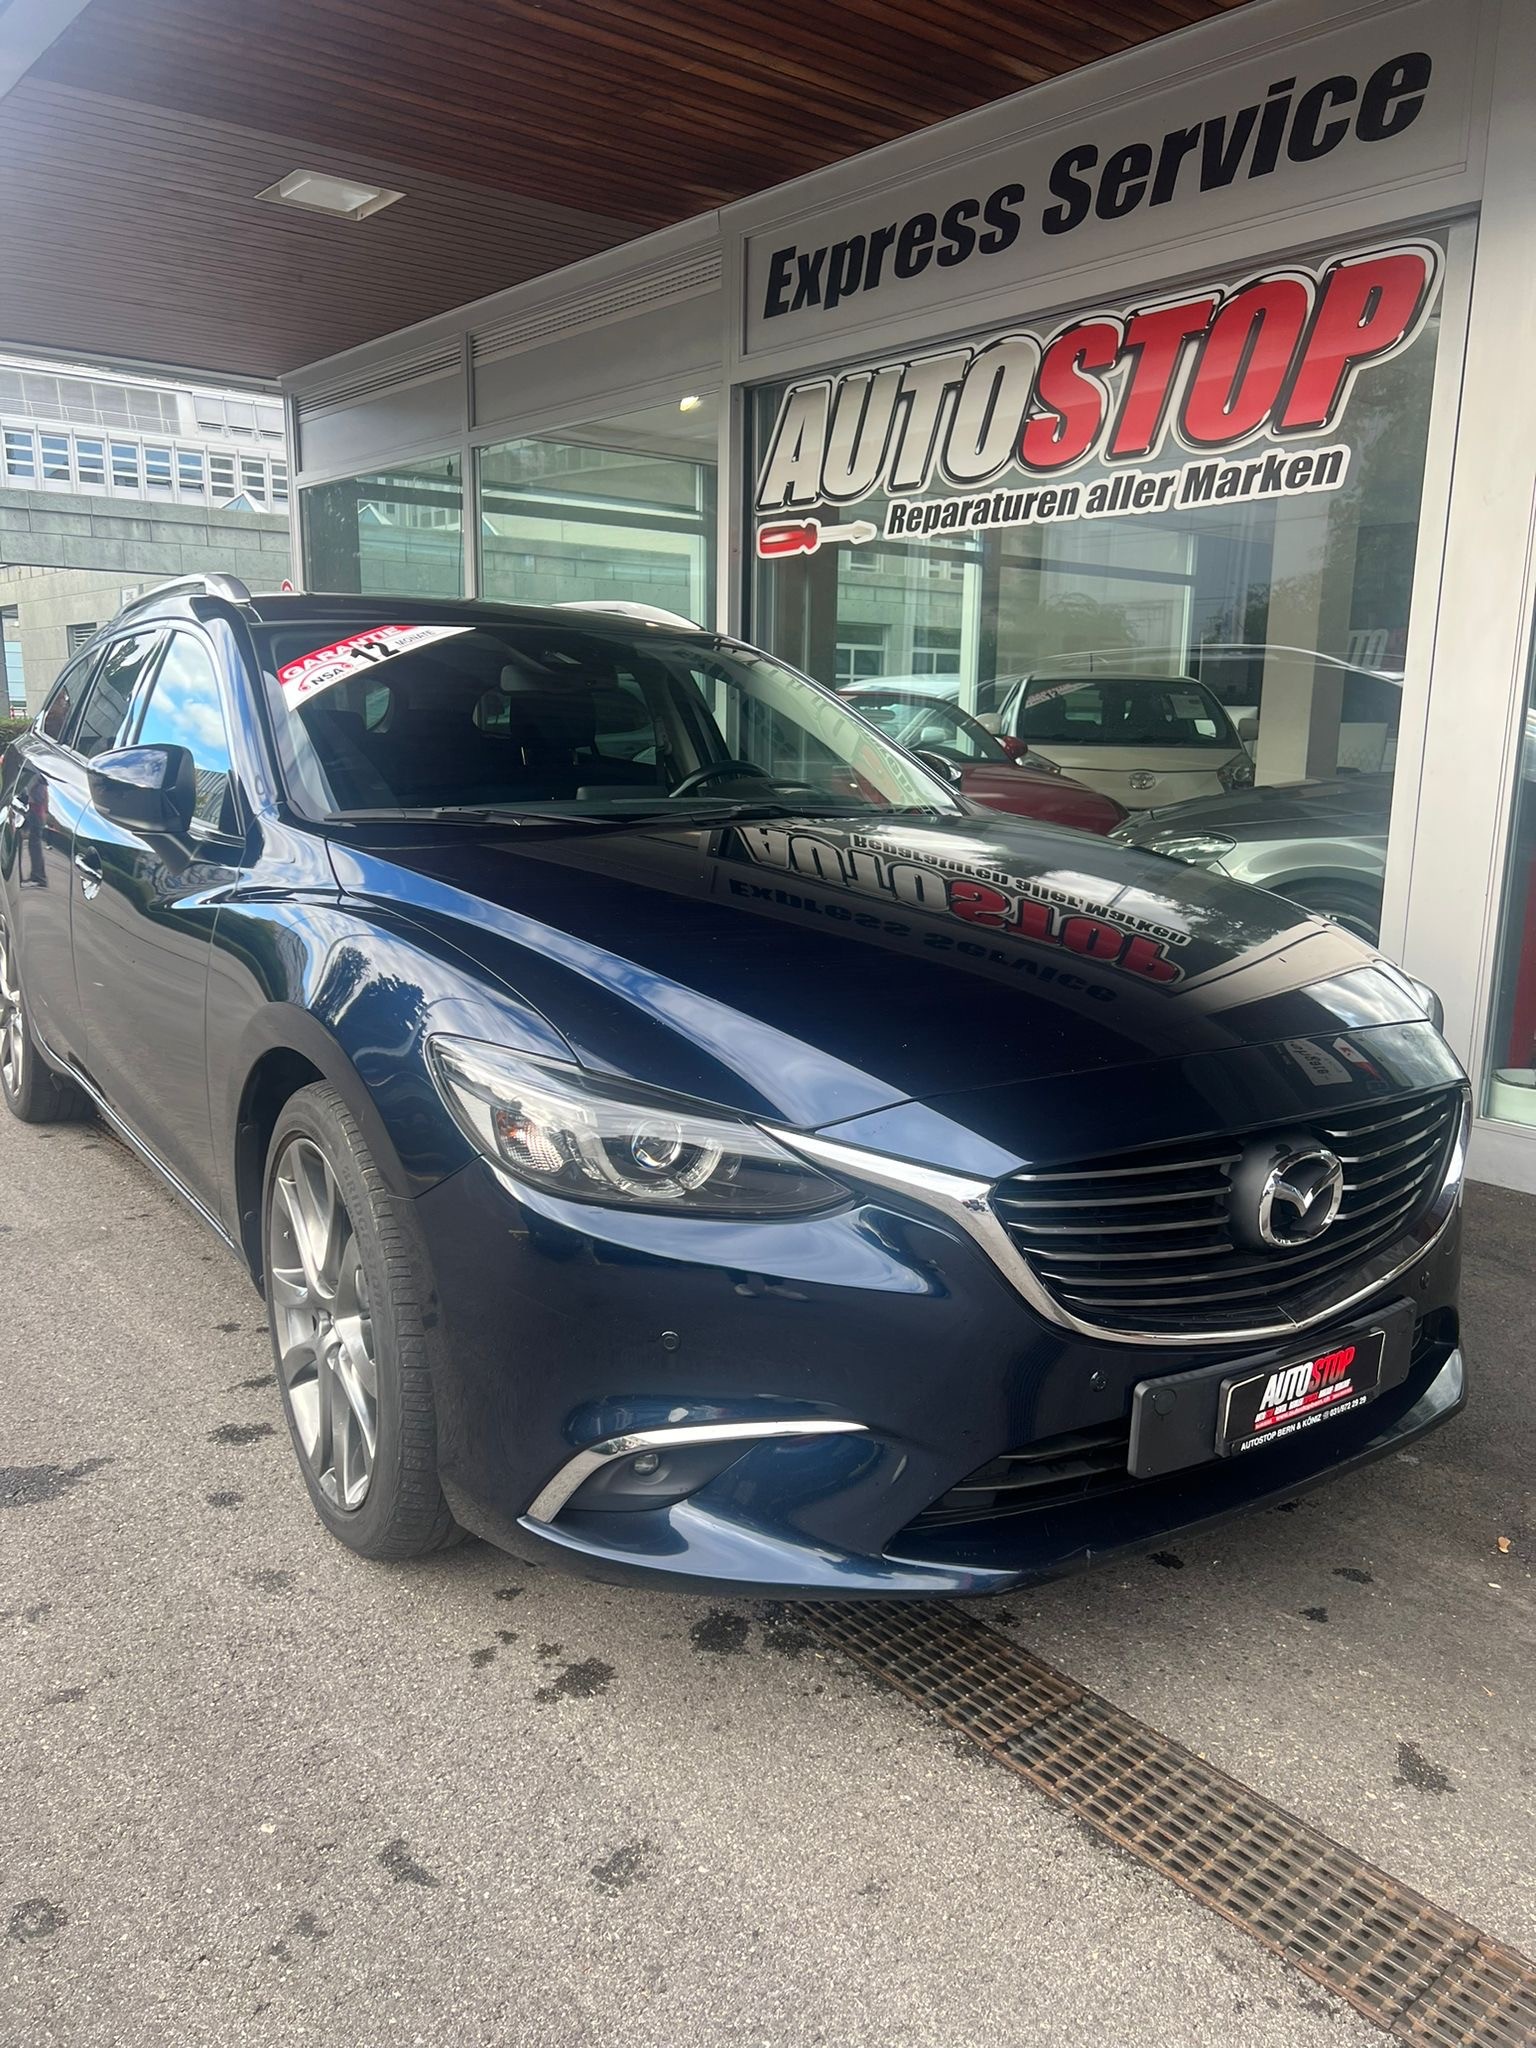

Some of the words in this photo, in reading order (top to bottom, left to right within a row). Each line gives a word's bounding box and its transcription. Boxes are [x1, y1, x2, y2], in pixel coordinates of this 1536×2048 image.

[763, 183, 1026, 319] Express
[1041, 51, 1433, 236] Service
[757, 242, 1442, 509] AUTOSTOP
[886, 486, 1081, 538] Reparaturen
[1084, 475, 1175, 513] aller
[1180, 446, 1344, 506] Marken
[282, 626, 401, 681] GARANTIE
[350, 642, 401, 663] 12
[394, 629, 435, 647] MONATE
[311, 667, 345, 686] NSA
[1259, 1346, 1356, 1412] AUTOSTOP
[1240, 1430, 1277, 1452] AUTOSTOP
[1276, 1423, 1296, 1437] BERN
[1296, 1421, 1302, 1430] &
[1302, 1413, 1322, 1428] KÖNIZ
